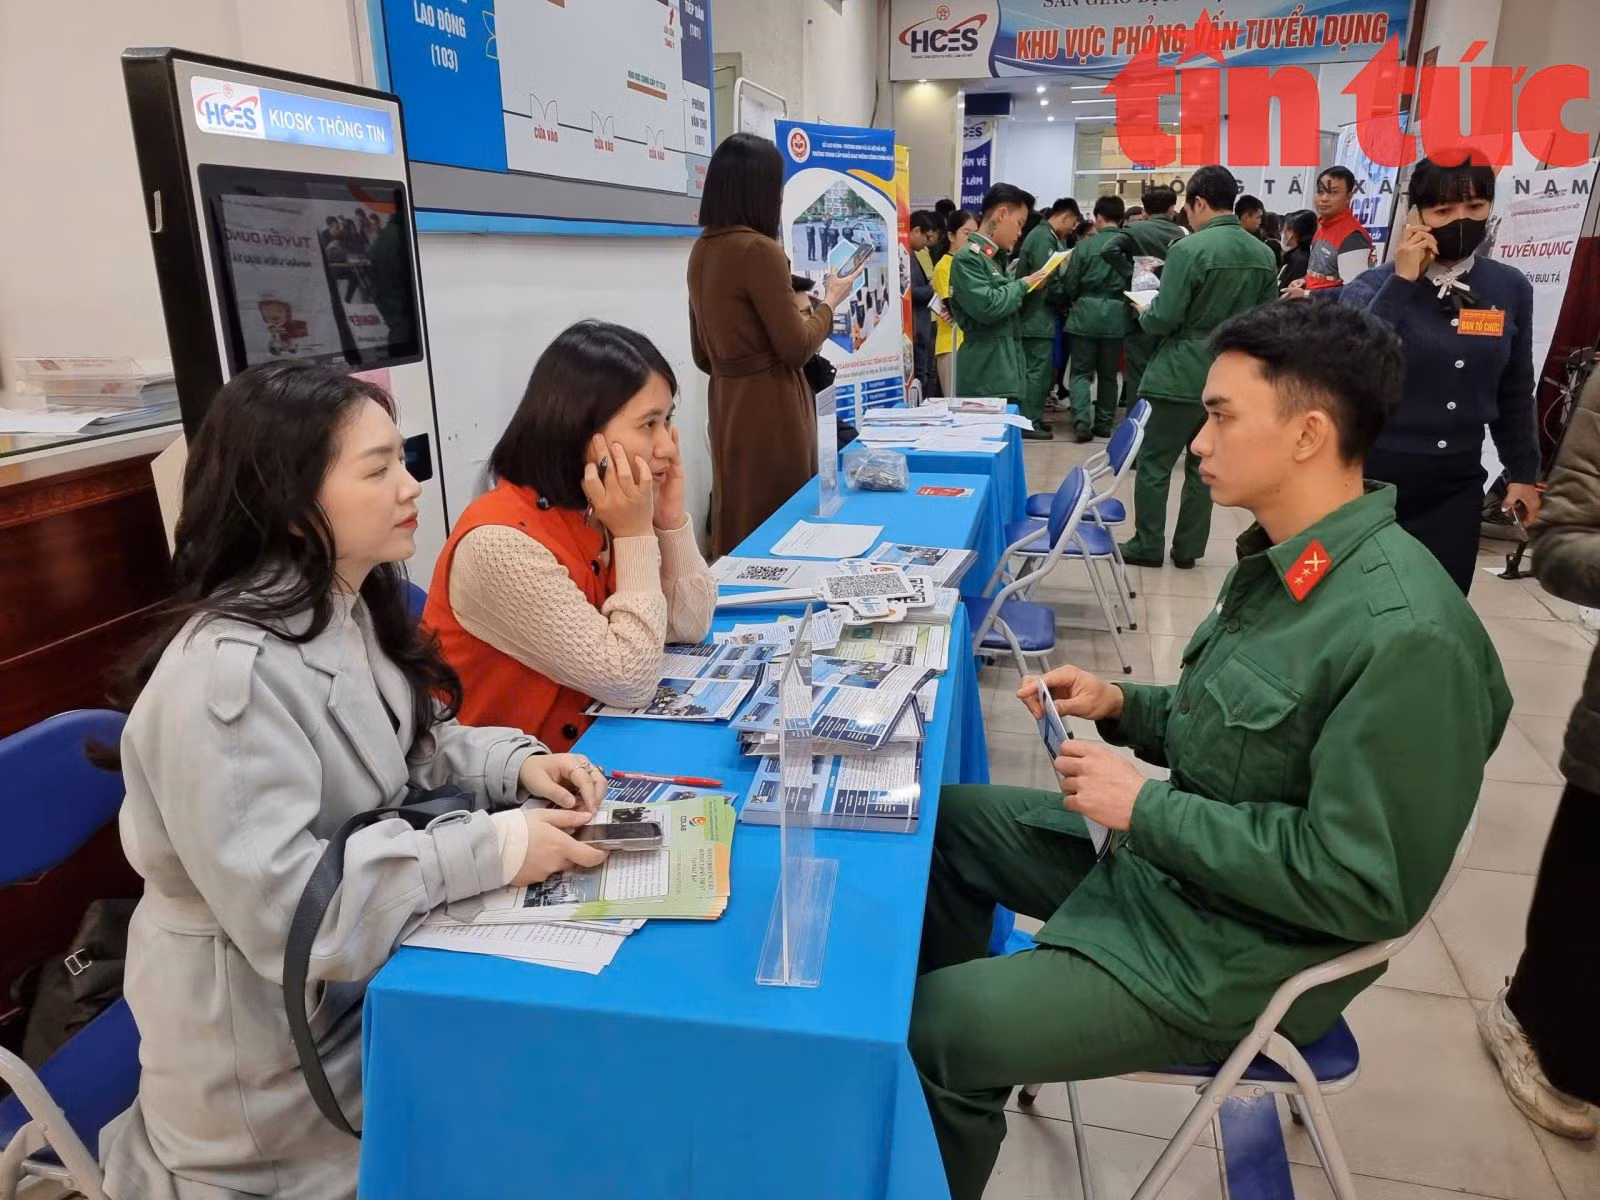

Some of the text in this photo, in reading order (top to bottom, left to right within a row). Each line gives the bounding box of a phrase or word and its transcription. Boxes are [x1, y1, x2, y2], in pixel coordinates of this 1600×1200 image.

[414, 0, 466, 38] LAO ĐỘNG
[911, 28, 978, 53] HCES
[1016, 29, 1060, 61] KHU
[1065, 25, 1105, 64] VỰC
[1111, 15, 1187, 56] PHỎNG
[1246, 5, 1318, 50] TUYỂN
[1322, 13, 1388, 52] DỤNG
[431, 43, 458, 72] (103)
[205, 101, 257, 131] HCES
[269, 108, 386, 143] KIOSK THÔNG TIN
[1500, 236, 1573, 259] TUYỂN DỤNG
